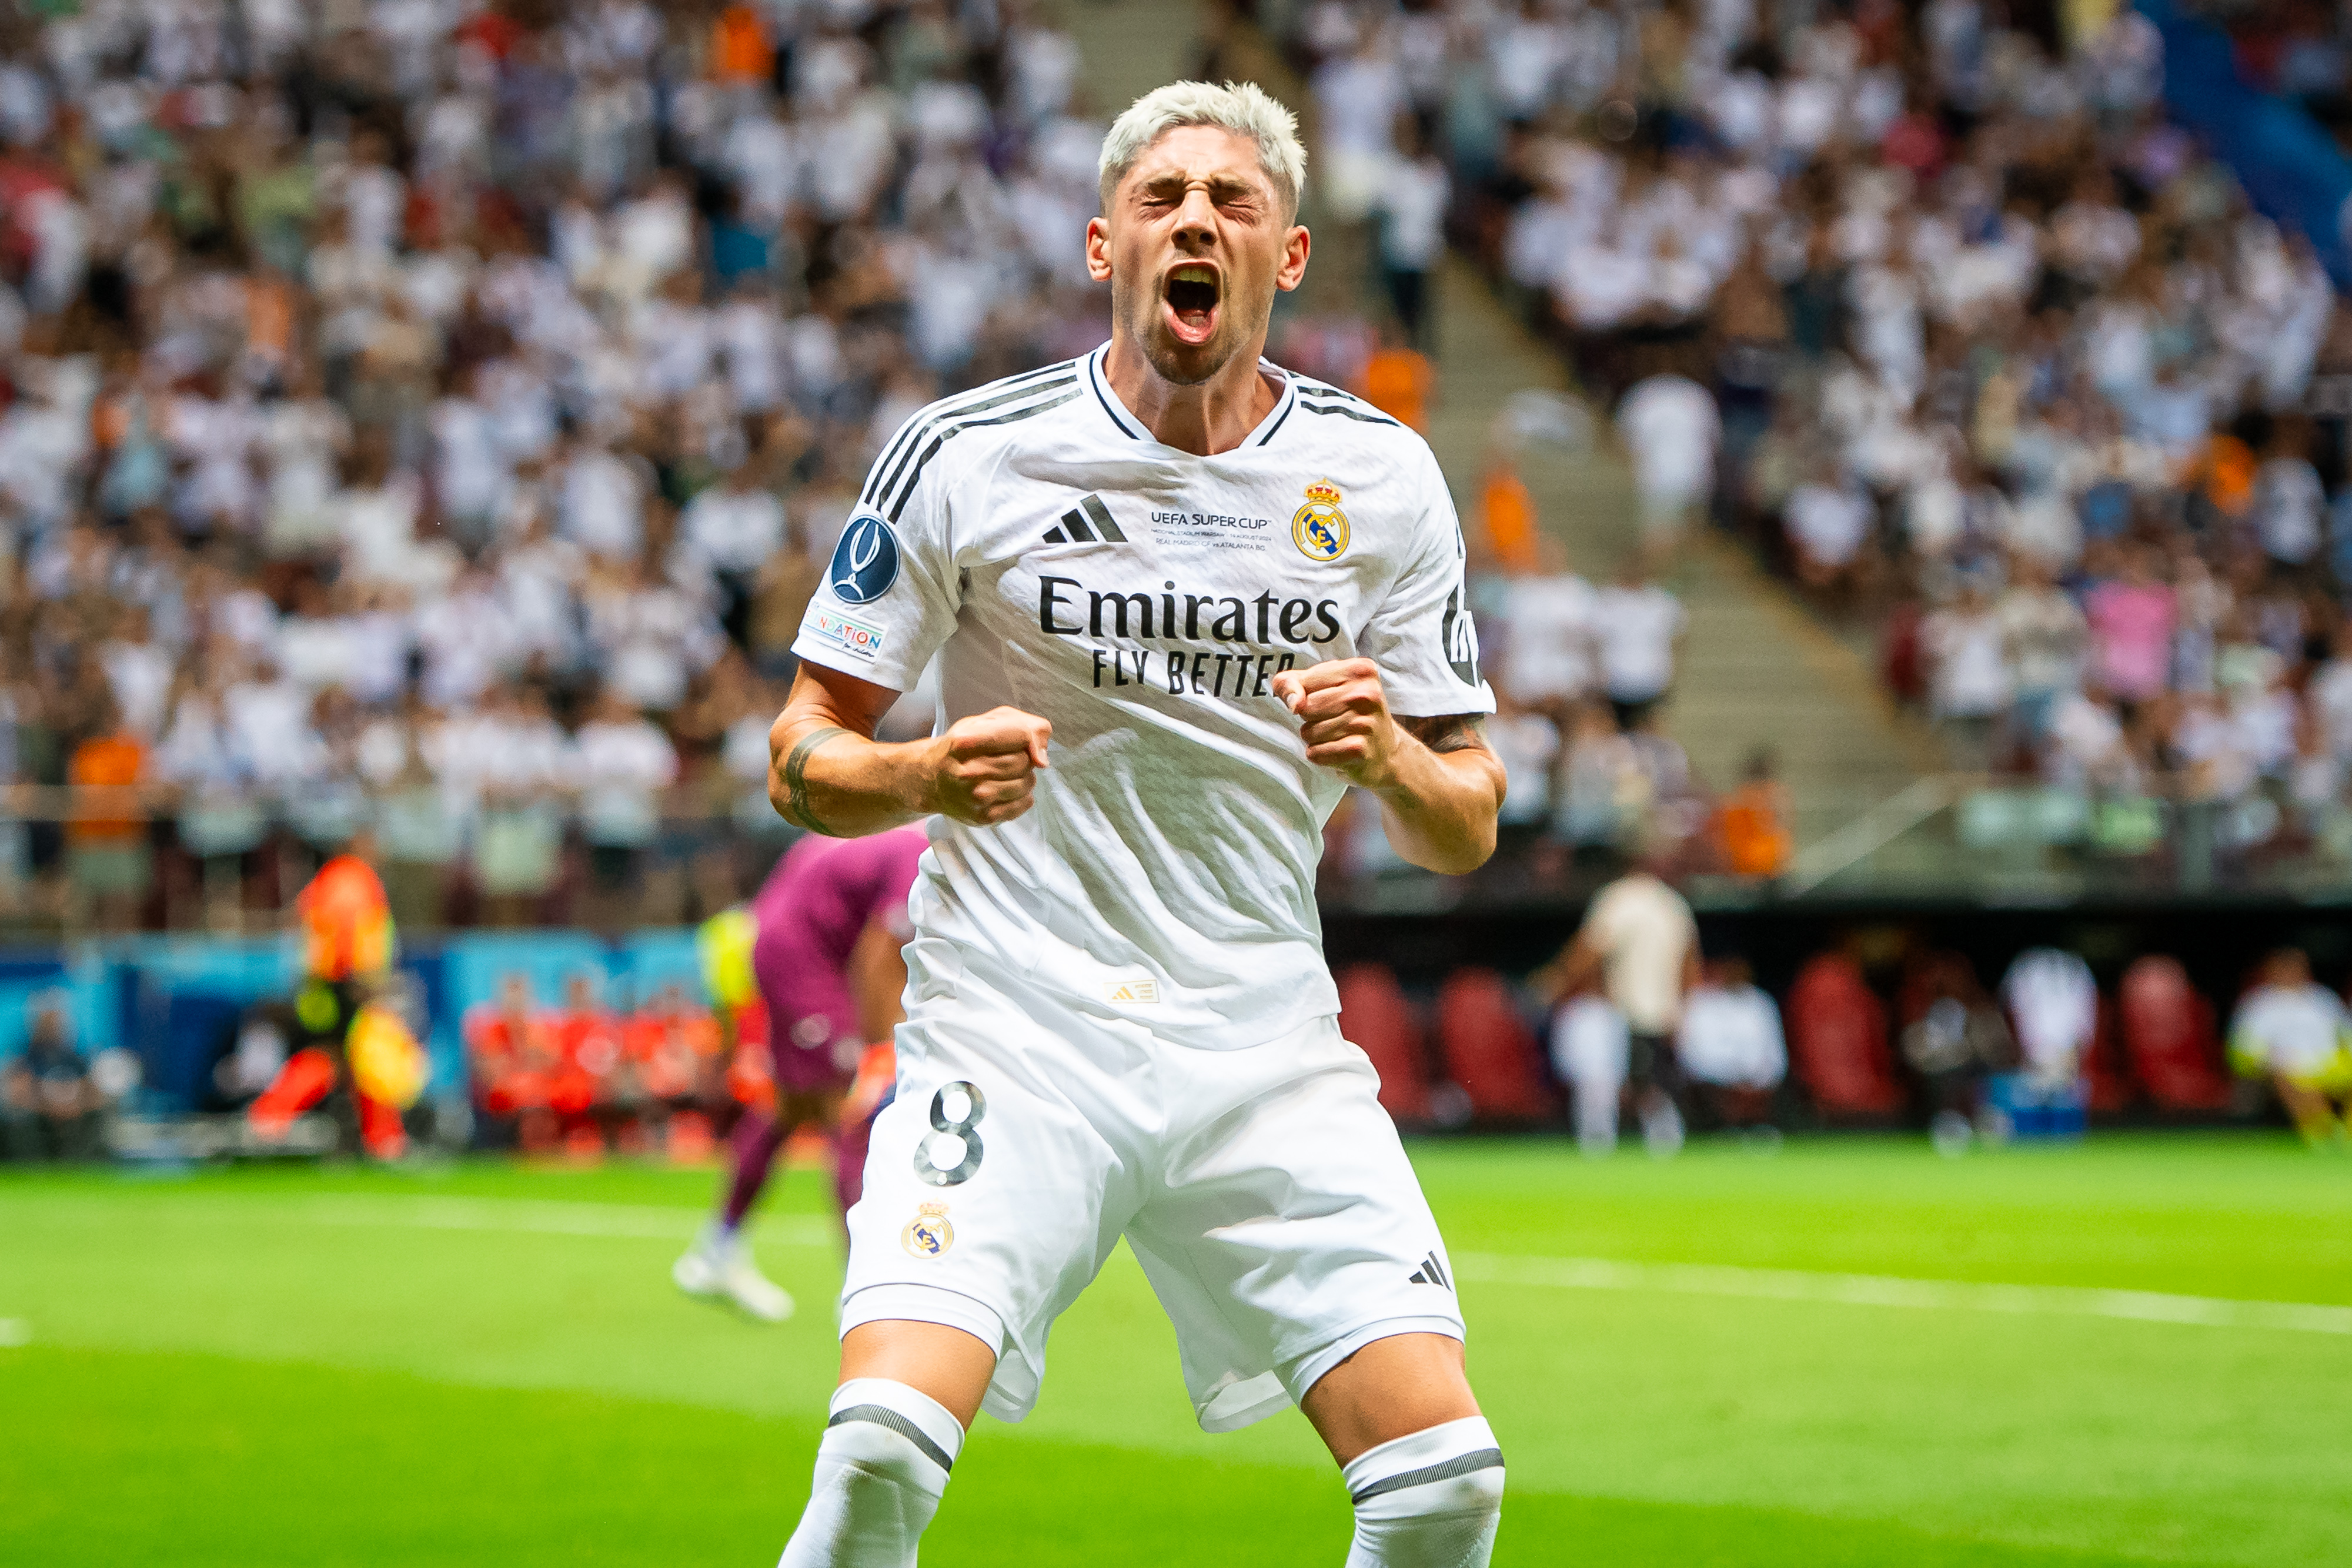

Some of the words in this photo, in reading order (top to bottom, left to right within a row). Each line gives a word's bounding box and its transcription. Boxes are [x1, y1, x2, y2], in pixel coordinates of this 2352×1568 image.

[1151, 512, 1188, 525] UEFA
[1192, 514, 1237, 527] SUPER
[1038, 575, 1340, 644] Emirates
[1093, 648, 1149, 688] FLY
[914, 1081, 987, 1187] 8
